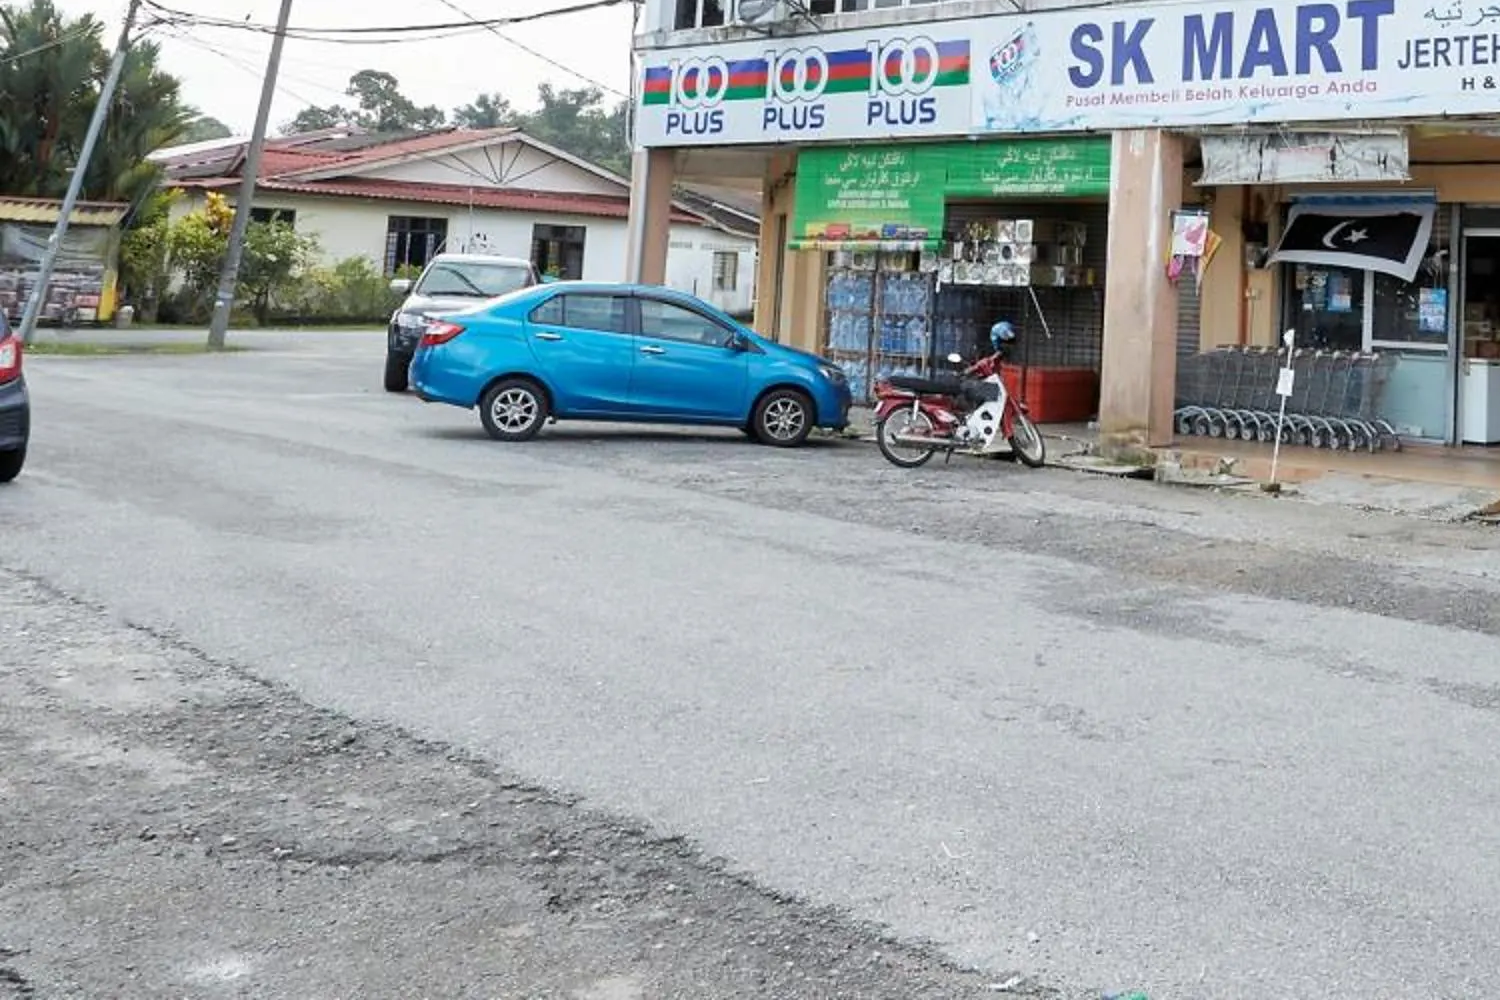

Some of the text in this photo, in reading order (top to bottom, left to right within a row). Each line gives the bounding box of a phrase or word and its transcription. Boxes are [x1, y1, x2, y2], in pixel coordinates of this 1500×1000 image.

[866, 34, 940, 99] 100
[1066, 17, 1156, 89] SK
[668, 54, 729, 110] 100
[763, 45, 829, 104] 100
[1238, 83, 1320, 101] Keluarga
[1326, 78, 1378, 94] Anda
[1461, 76, 1475, 90] H
[1482, 75, 1497, 90] &
[666, 109, 724, 135] PLUS
[762, 104, 826, 130] PLUS
[866, 97, 937, 127] PLUS
